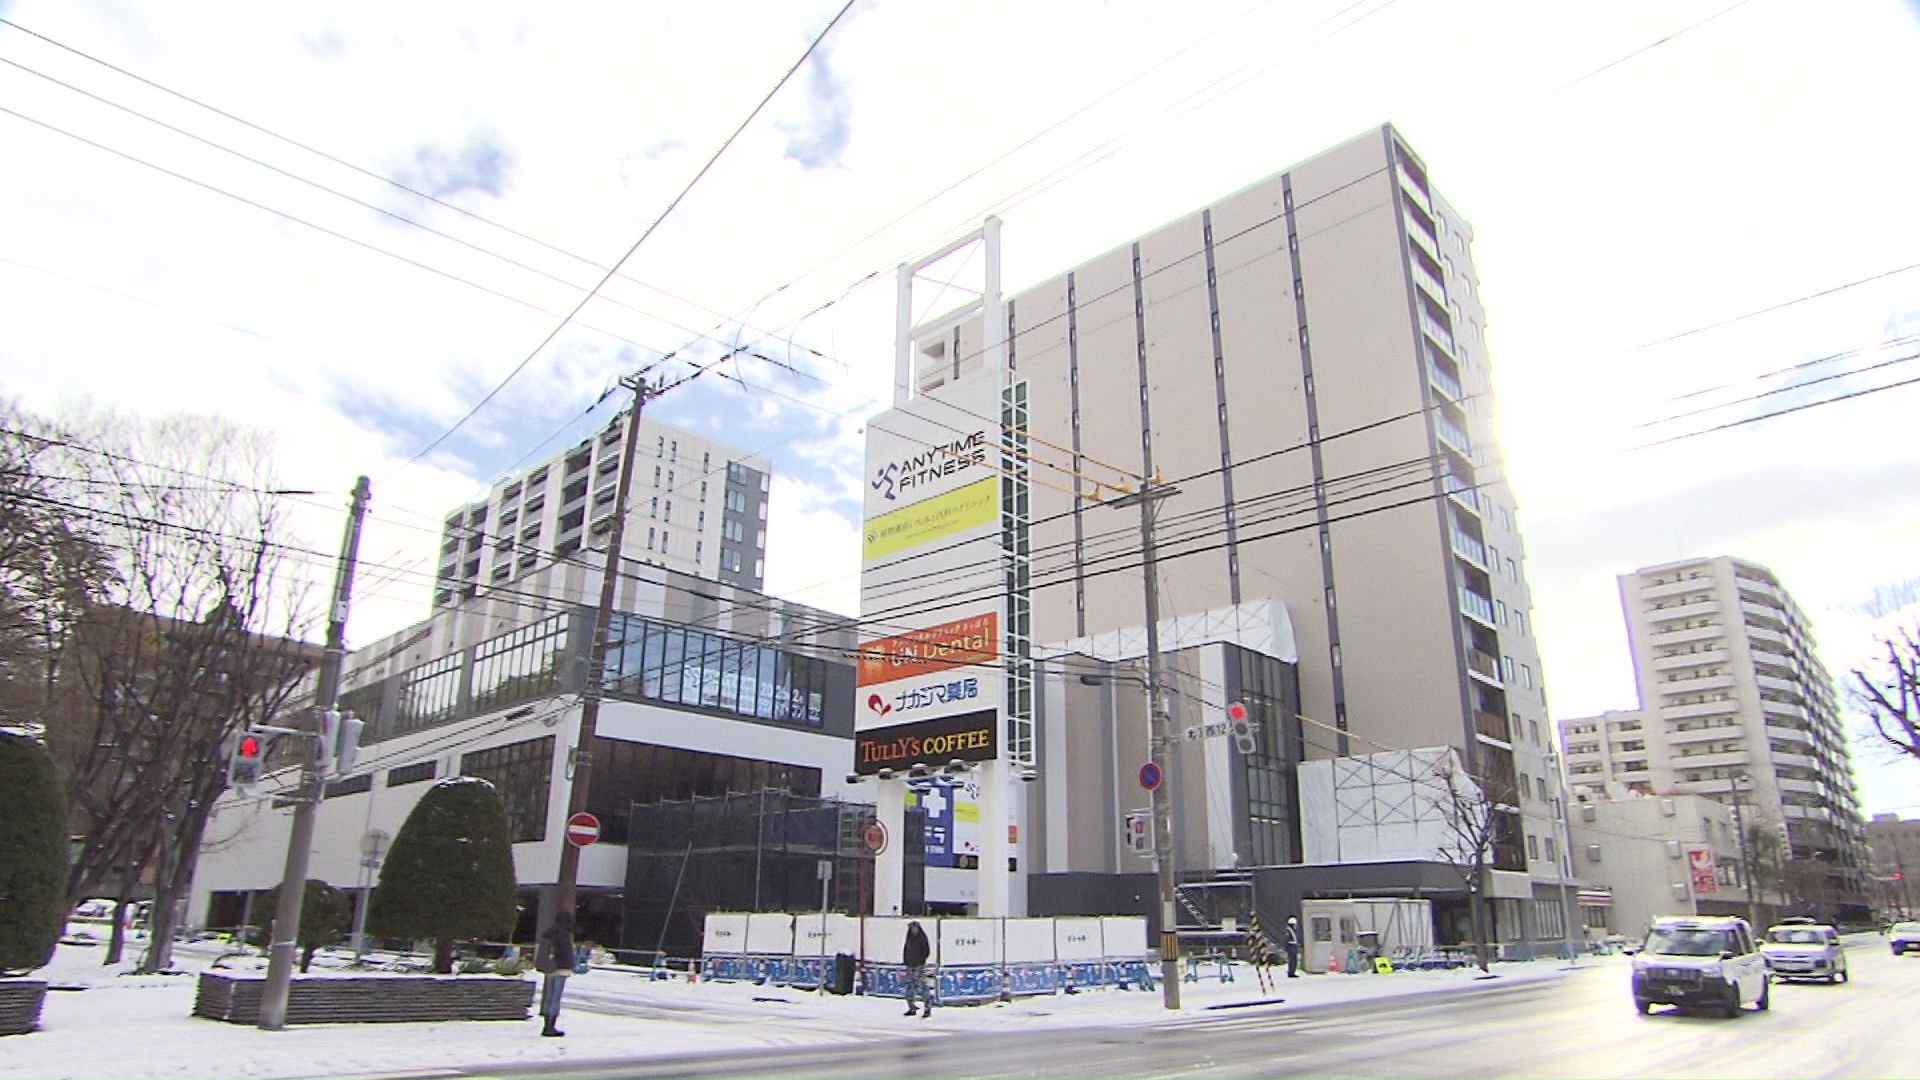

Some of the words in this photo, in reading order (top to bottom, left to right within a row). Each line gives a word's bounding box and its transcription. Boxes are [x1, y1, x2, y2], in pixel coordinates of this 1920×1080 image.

[899, 449, 986, 492] FITNESS
[900, 431, 986, 475] ANYTIME
[923, 626, 989, 659] Dental
[895, 677, 978, 712] ナカジマ薬局
[923, 729, 989, 754] COFFEE
